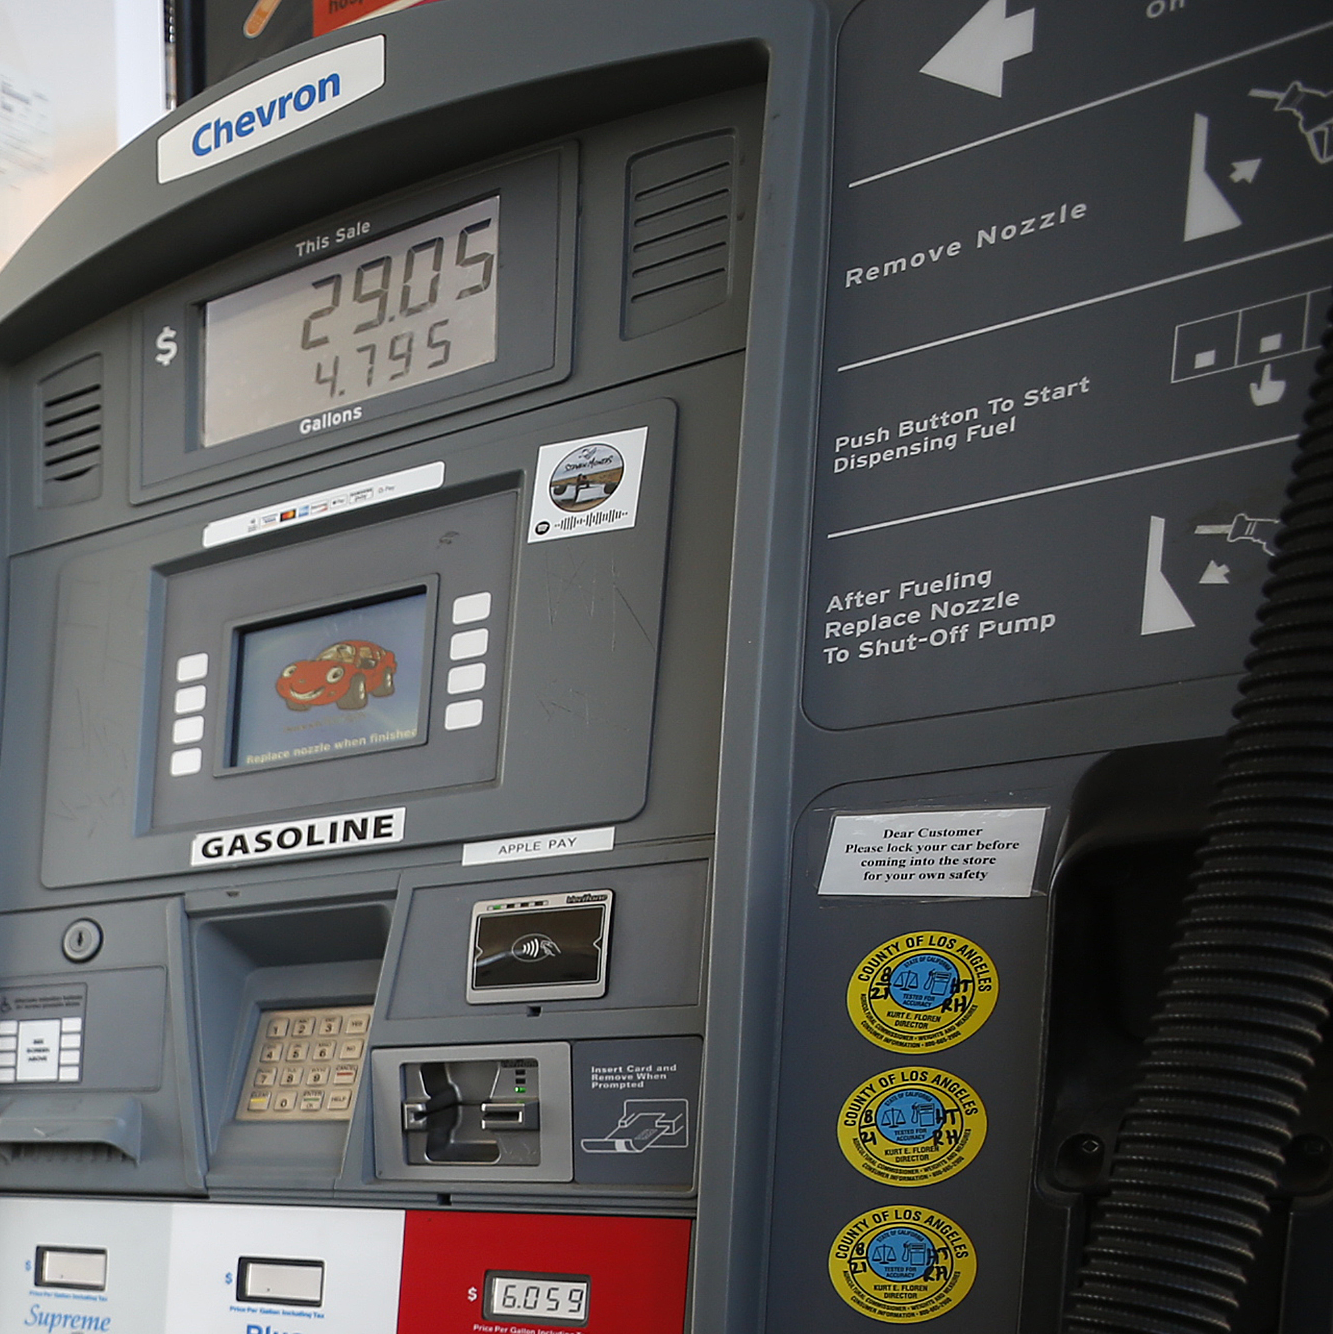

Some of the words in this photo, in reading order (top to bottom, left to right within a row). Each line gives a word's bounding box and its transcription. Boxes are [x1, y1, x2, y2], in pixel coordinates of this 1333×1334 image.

[192, 72, 341, 156] Chevron
[296, 235, 330, 257] This
[335, 221, 371, 244] Sale
[845, 239, 961, 289] Remove
[976, 202, 1087, 249] Nozzle
[301, 218, 494, 351] 29.05
[155, 326, 177, 366] $
[315, 319, 451, 398] 4.795
[300, 406, 362, 435] Gallons
[835, 426, 890, 453] Push
[898, 403, 979, 436] Button
[988, 395, 1015, 414] To
[1023, 376, 1090, 407] Start
[834, 432, 957, 473] Dispensing
[967, 417, 1016, 444] Fuel
[826, 585, 890, 613] After
[899, 568, 992, 601] Fueling
[824, 608, 921, 640] Replace
[931, 589, 1020, 619] Nozzle
[823, 646, 850, 665] To
[858, 625, 968, 660] Shut-Off
[979, 610, 1056, 639] Pump
[246, 750, 290, 764] Replace
[294, 743, 330, 756] nozzle
[335, 737, 366, 749] when
[201, 812, 395, 860] GASOLINE
[883, 829, 914, 839] Dear
[918, 827, 983, 838] Customer
[498, 841, 541, 854] APPLE
[548, 837, 577, 849] PAY
[845, 844, 883, 854] Please
[887, 843, 912, 852] lock
[916, 844, 947, 854] your
[951, 842, 973, 851] car
[977, 840, 1019, 850] before
[861, 857, 906, 868] coming
[910, 856, 935, 865] into
[939, 856, 959, 865] the
[963, 856, 996, 865] store
[863, 871, 882, 881] for
[885, 872, 915, 883] your
[919, 872, 945, 880] own
[949, 870, 988, 881] safety
[858, 942, 900, 981] COUNTY
[906, 936, 924, 948] OF
[929, 935, 957, 949] LOS
[957, 944, 991, 992] ANGELES
[904, 958, 918, 968] STATE
[927, 956, 952, 971] CALIFORNIA
[887, 1011, 905, 1019] KURT
[906, 1012, 912, 1020] E.
[914, 1013, 941, 1022] FLOREN
[895, 1020, 928, 1029] DIRECTOR
[875, 1023, 915, 1040] COMMISSIONER
[919, 1029, 944, 1040] WEIGHTS
[945, 1024, 956, 1034] AND
[884, 1038, 920, 1048] INFORMATION
[591, 1065, 623, 1074] Insert
[627, 1065, 652, 1073] Card
[657, 1064, 677, 1072] and
[592, 1073, 633, 1081] Remove
[592, 1081, 644, 1090] Prompted
[844, 1084, 877, 1126] COUNTY
[879, 1074, 895, 1088] OF
[901, 1070, 928, 1082] LOS
[931, 1074, 979, 1116] ANGELES
[885, 1095, 898, 1106] STATE
[905, 1091, 933, 1102] CALIFORNIA
[885, 1148, 903, 1156] KURT
[913, 1146, 939, 1154] FLOREN
[895, 1154, 929, 1162] DIRECTOR
[835, 1218, 869, 1259] COUNTY
[872, 1211, 889, 1224] OF
[895, 1210, 922, 1221] LOS
[924, 1216, 969, 1259] ANGELES
[224, 1272, 233, 1285] $
[467, 1286, 477, 1302] $
[874, 1284, 892, 1292] KURT
[901, 1284, 928, 1292] FLOREN
[503, 1285, 584, 1313] 6.059
[24, 1303, 111, 1333] Supreme
[282, 1309, 312, 1319] Including
[474, 1324, 493, 1332] Price
[510, 1327, 535, 1334] Gallon
